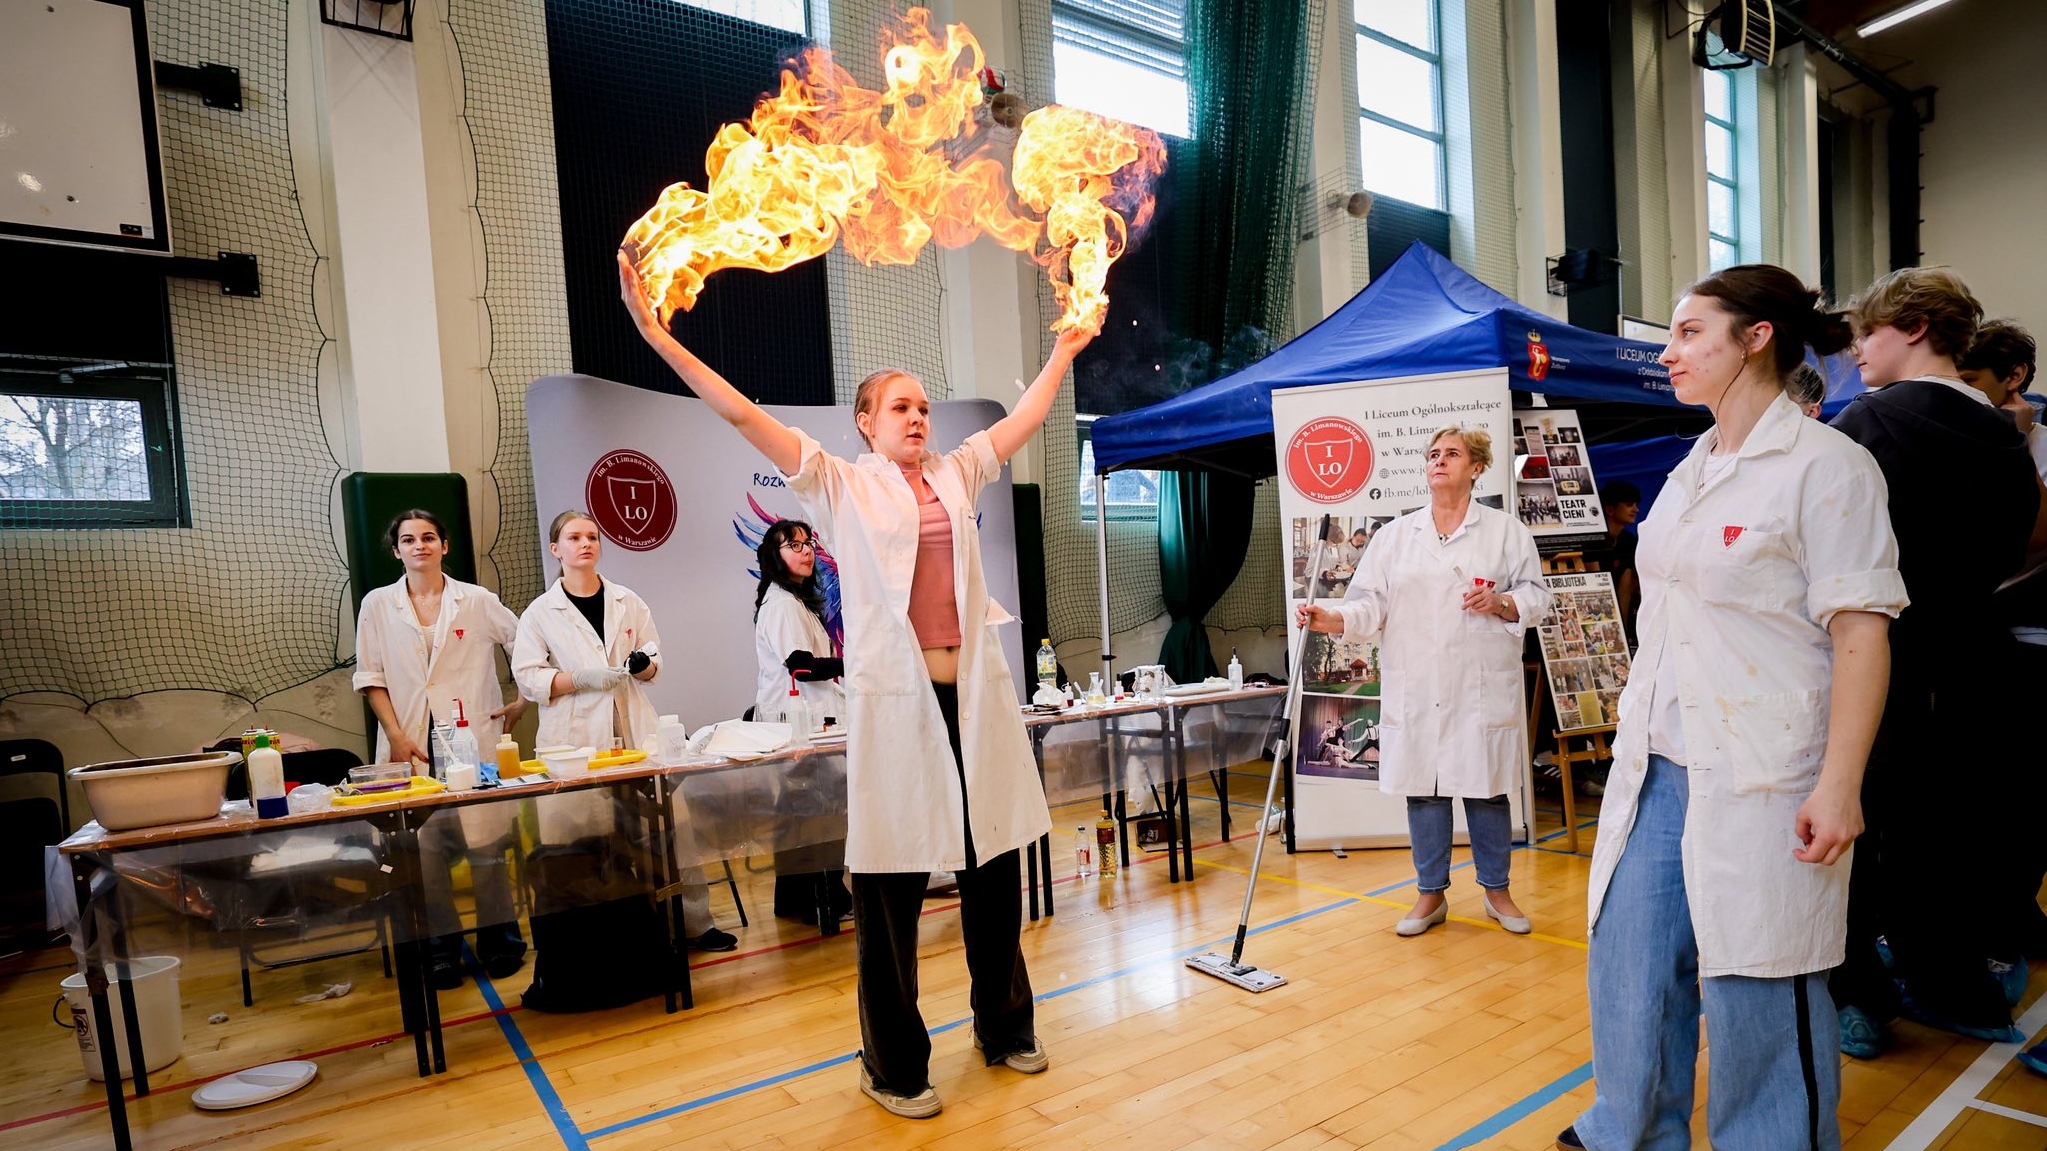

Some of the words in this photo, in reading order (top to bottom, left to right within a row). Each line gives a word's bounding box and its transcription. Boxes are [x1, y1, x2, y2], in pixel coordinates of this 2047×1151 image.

[1620, 347, 1647, 362] LICEUM
[1372, 410, 1409, 419] Liceum
[1411, 400, 1502, 418] Ogólnokształcące
[1293, 436, 1305, 449] im.
[1302, 430, 1311, 438] B.
[1310, 422, 1363, 443] Limanowskiego
[1377, 429, 1393, 438] im.
[1396, 428, 1406, 437] B.
[1325, 445, 1333, 458] I
[595, 466, 608, 478] im.
[606, 460, 616, 468] B.
[615, 456, 665, 485] Limanowskiego
[1318, 462, 1343, 476] LO
[630, 486, 636, 500] I
[1317, 488, 1353, 500] Warszawie
[1560, 499, 1587, 509] TEATR
[624, 505, 648, 520] LO
[1562, 509, 1585, 519] CIENI
[625, 536, 657, 546] Warszawie
[1551, 576, 1587, 588] BIBLIOTEKA
